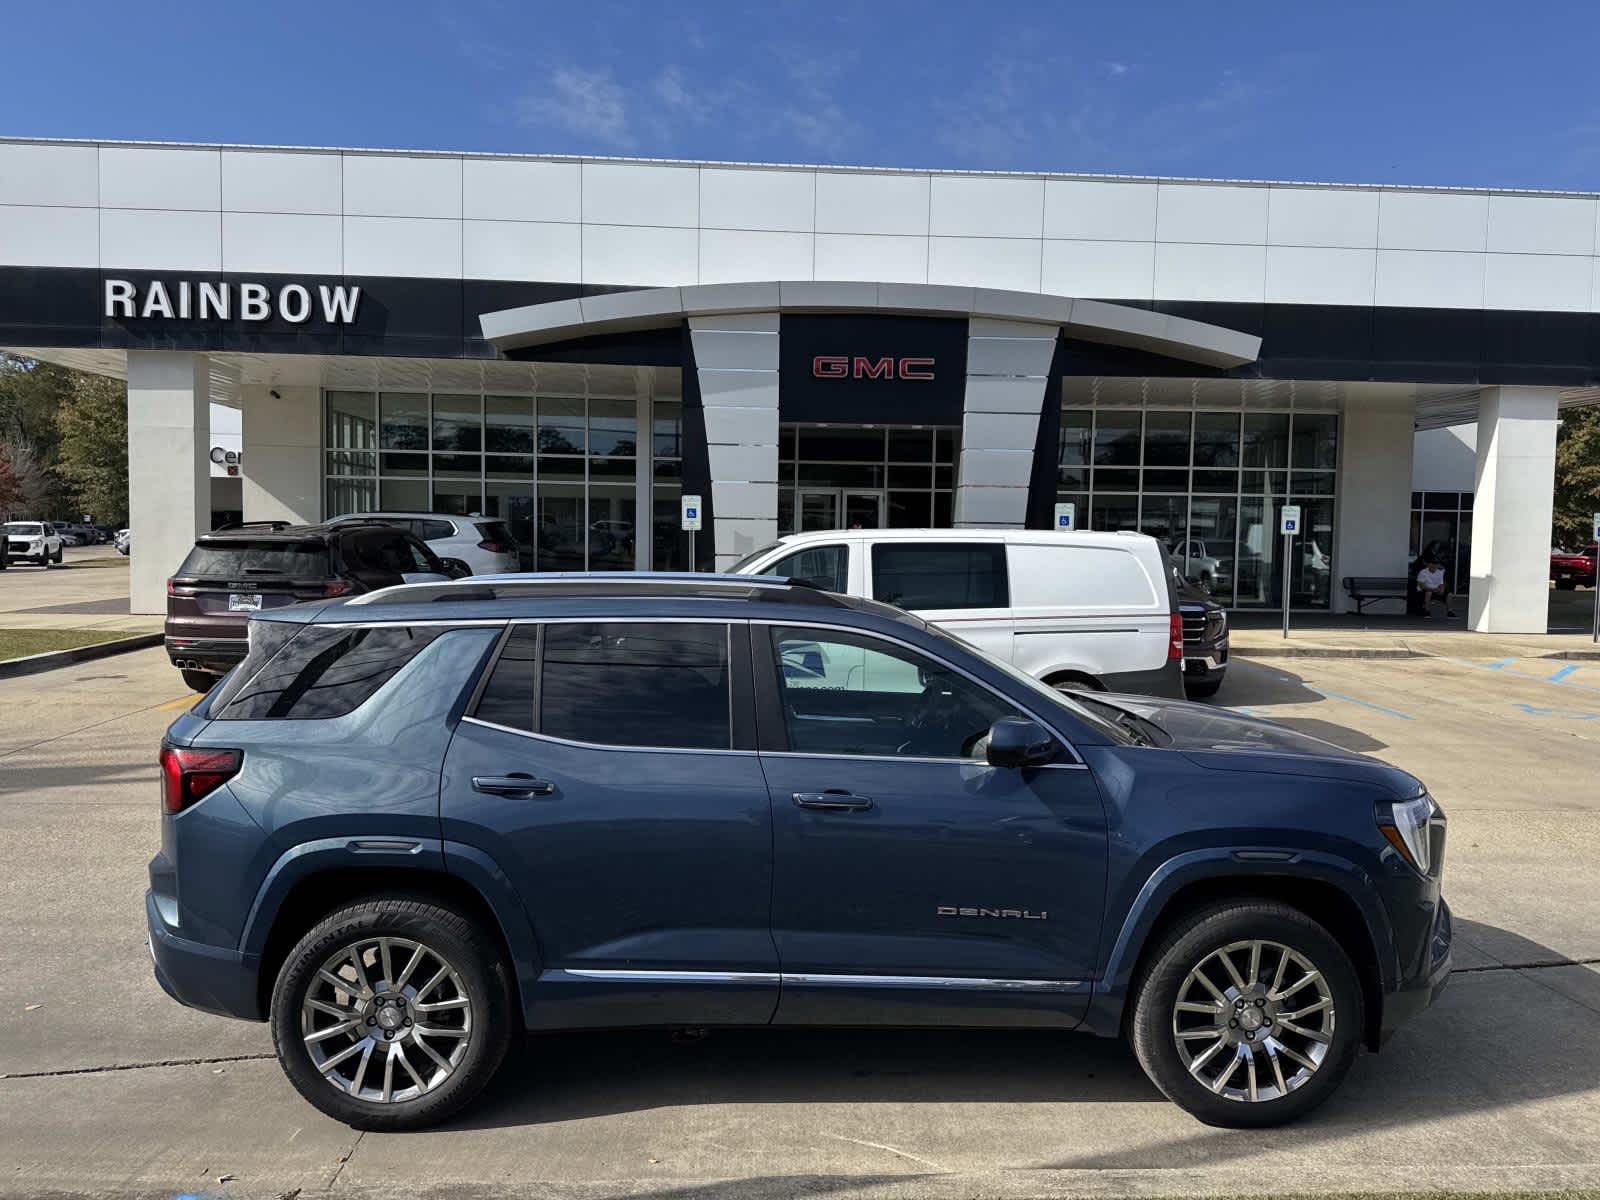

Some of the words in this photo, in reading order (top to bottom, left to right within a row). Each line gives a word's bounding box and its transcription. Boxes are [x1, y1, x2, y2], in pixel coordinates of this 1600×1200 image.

[104, 279, 361, 324] RAINBOW
[813, 356, 935, 380] GMC
[937, 906, 1047, 920] DENALI
